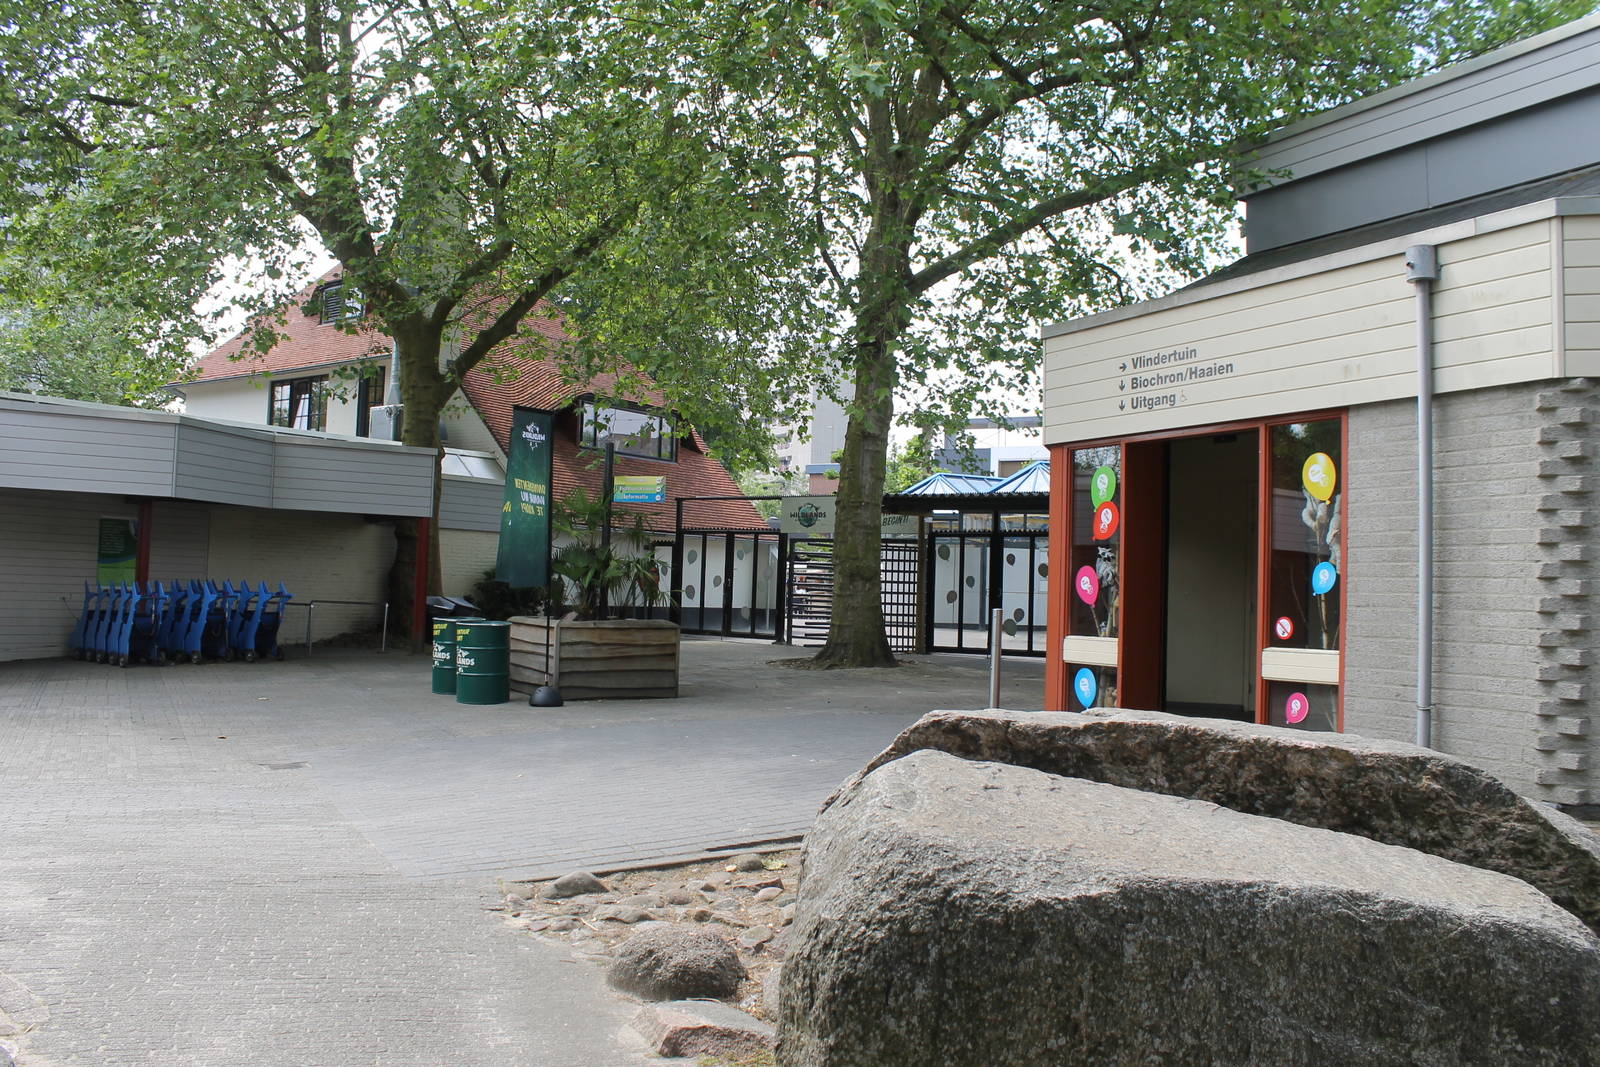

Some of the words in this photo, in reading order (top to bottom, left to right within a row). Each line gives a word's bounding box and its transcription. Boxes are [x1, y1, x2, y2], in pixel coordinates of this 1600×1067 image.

[1131, 347, 1197, 369] Vlindertuin
[1131, 363, 1233, 389] Biochron/Haaien
[1131, 394, 1176, 410] Uitgang
[790, 511, 827, 519] WILDLANDS
